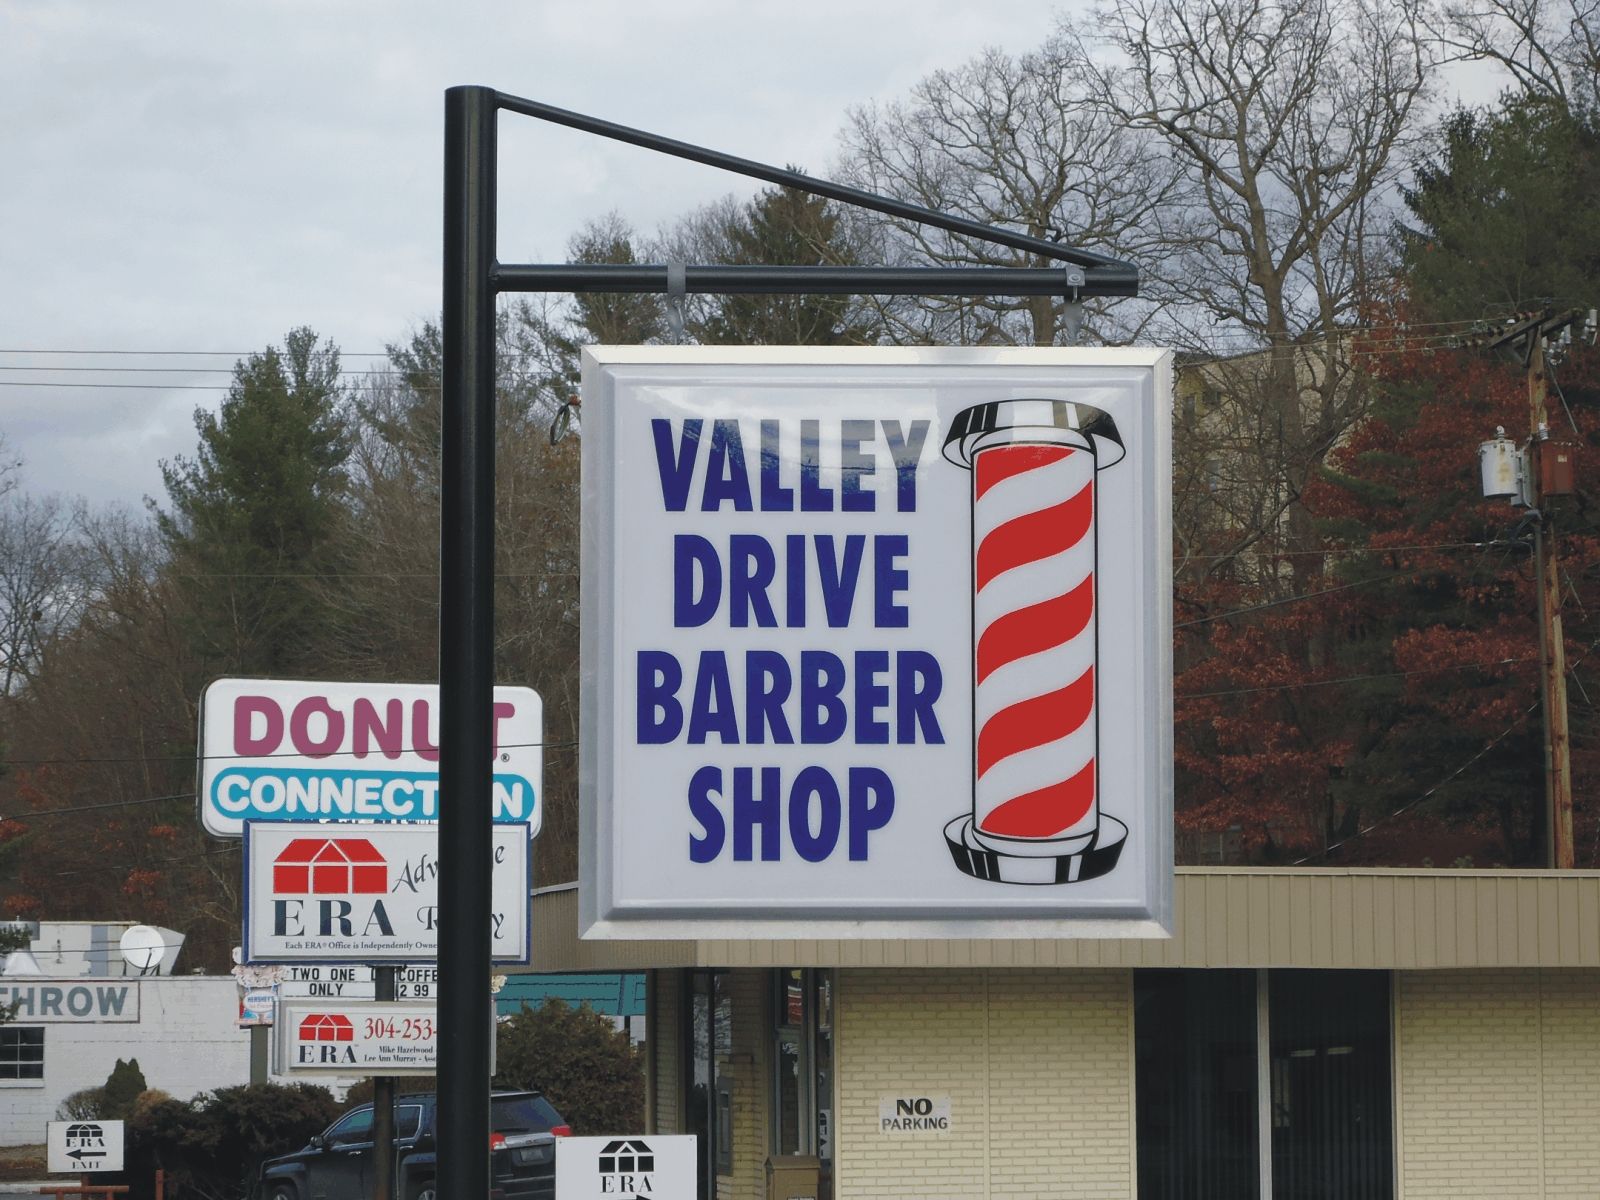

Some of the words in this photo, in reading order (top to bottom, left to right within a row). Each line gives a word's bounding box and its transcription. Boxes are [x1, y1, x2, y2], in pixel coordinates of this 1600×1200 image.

[651, 418, 931, 513] VALLEY
[673, 534, 910, 629] DRIVE
[636, 650, 946, 746] BARBER
[216, 773, 524, 819] CONNECTN
[687, 764, 896, 864] SHOP
[270, 898, 398, 938] ERA
[285, 941, 302, 950] Each
[328, 941, 351, 950] Office
[353, 942, 359, 950] is
[361, 941, 413, 951] Independently
[291, 967, 320, 981] TWO
[330, 968, 356, 981] ONE
[309, 983, 344, 996] ONLY
[399, 984, 407, 997] 2
[413, 984, 429, 997] 99
[298, 1044, 357, 1064] ERA
[379, 1045, 396, 1054] Mike
[397, 1045, 434, 1054] Hazelwood
[364, 1054, 377, 1062] Lee
[393, 1054, 416, 1064] Murray
[896, 1098, 933, 1116] NO
[881, 1116, 948, 1131] PARKING
[65, 1137, 105, 1148] ERA
[71, 1160, 102, 1170] EXIT
[600, 1174, 653, 1194] ERA
